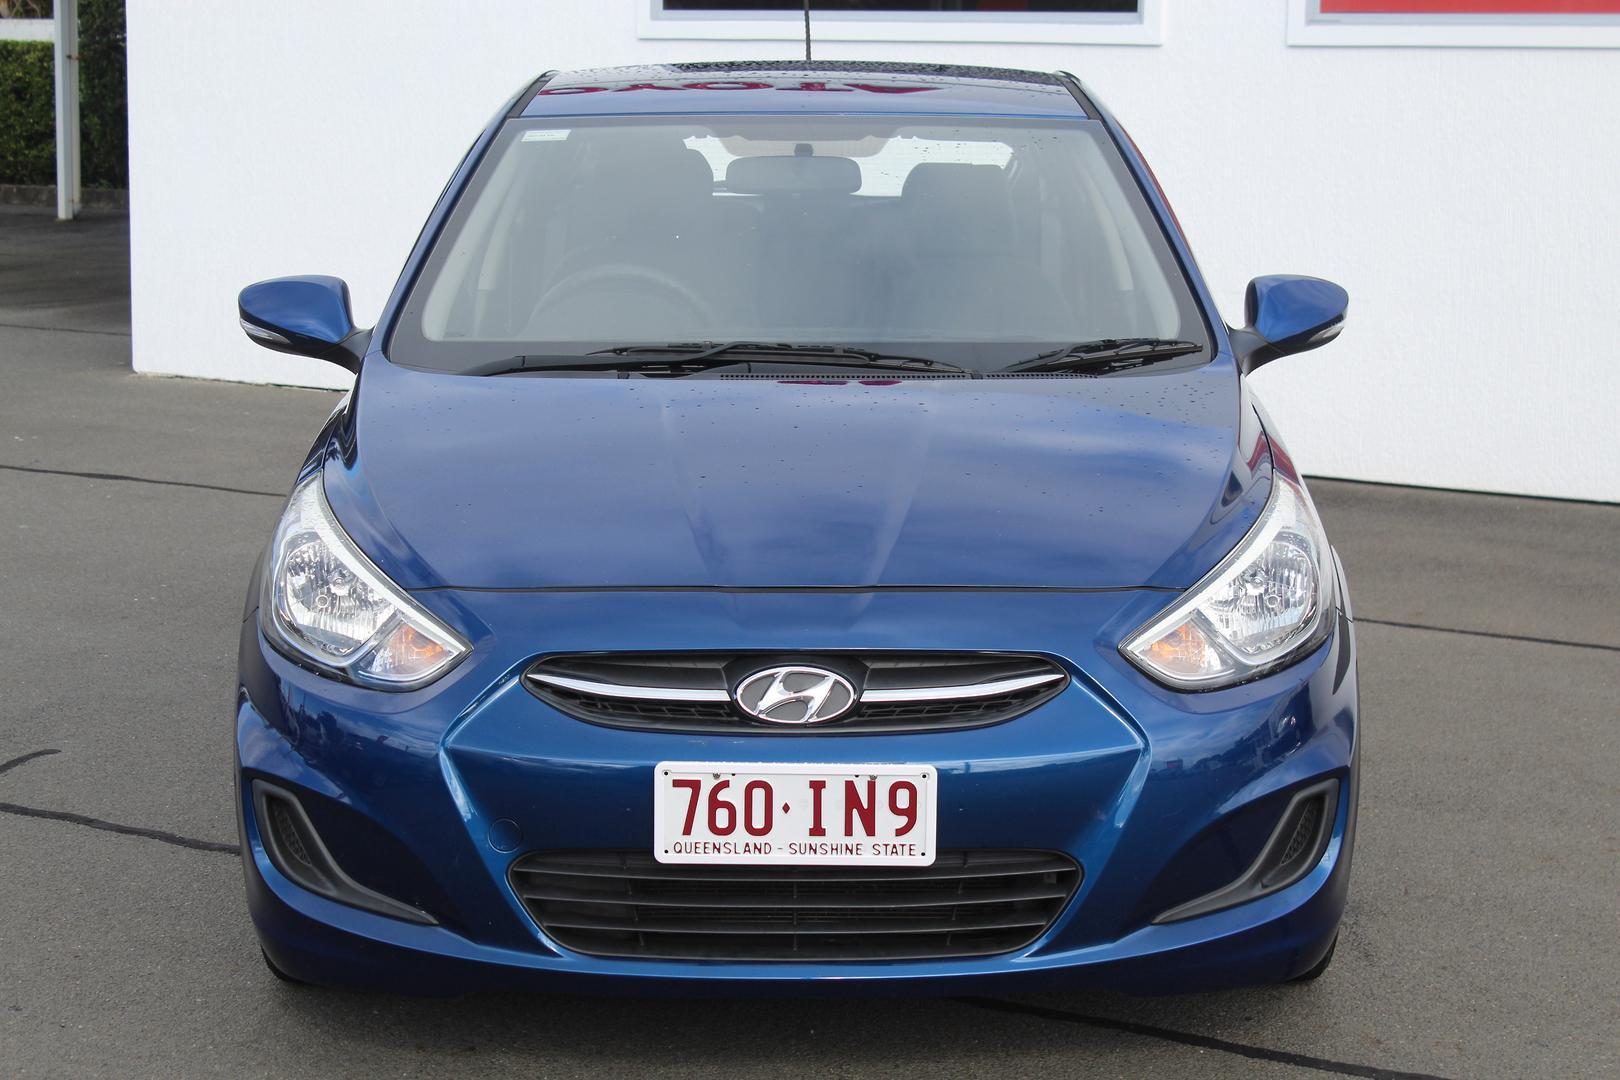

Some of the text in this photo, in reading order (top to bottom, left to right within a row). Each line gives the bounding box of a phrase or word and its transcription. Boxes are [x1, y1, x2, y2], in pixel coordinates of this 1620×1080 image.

[673, 841, 772, 855] QUEENSLAND
[788, 842, 863, 856] SUNSHINE
[872, 843, 916, 856] STATE
